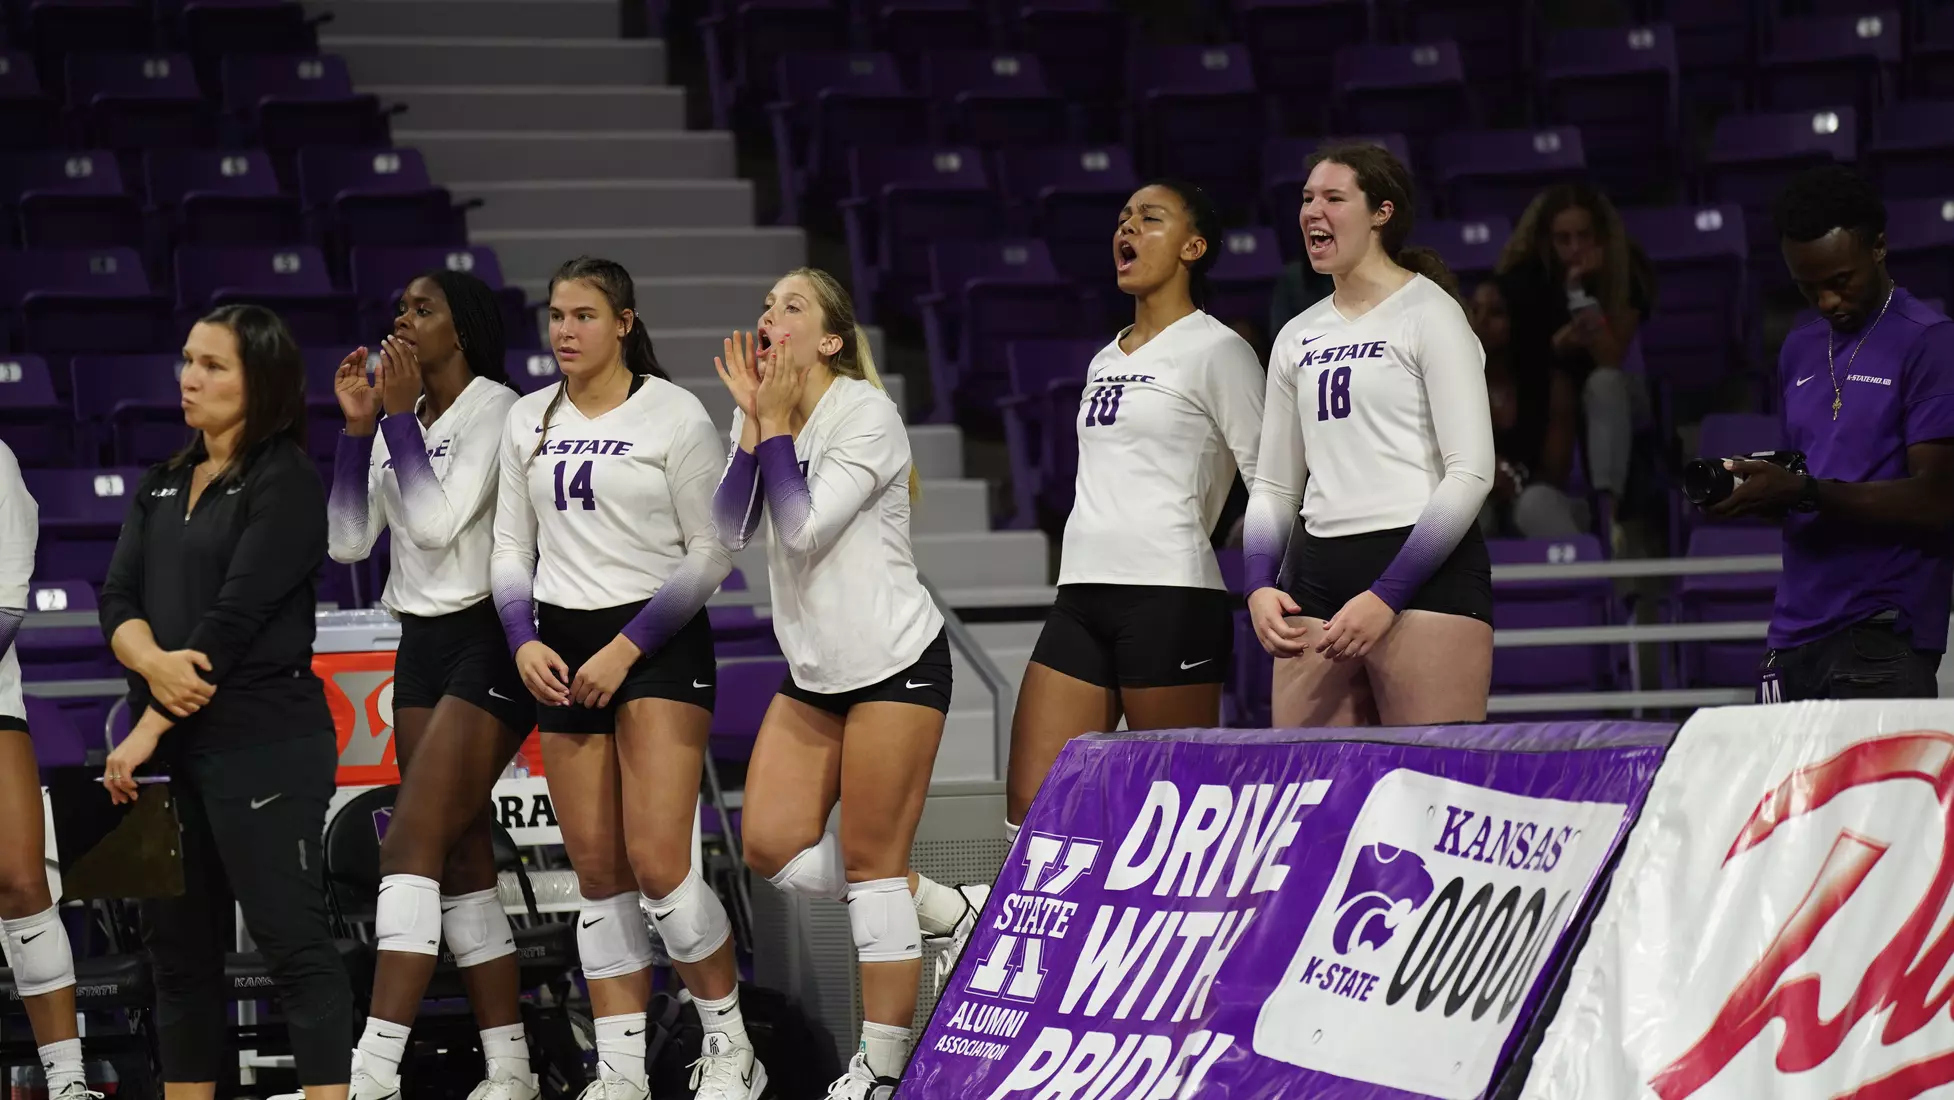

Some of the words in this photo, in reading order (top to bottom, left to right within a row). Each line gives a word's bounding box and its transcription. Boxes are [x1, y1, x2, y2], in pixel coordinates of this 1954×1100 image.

[1299, 341, 1387, 367] K-STATE
[1085, 384, 1126, 427] 10
[1317, 366, 1352, 422] 18
[536, 440, 634, 456] K-STATE
[553, 460, 596, 511] 14
[498, 794, 558, 828] RA
[1104, 780, 1333, 898] DRIVE
[1433, 805, 1572, 873] KANSAS
[993, 893, 1079, 939] STATE
[234, 976, 275, 988] KANS
[1058, 905, 1257, 1022] WITH
[1299, 956, 1380, 1002] K-STATE
[76, 984, 118, 998] STATE
[946, 1001, 1029, 1038] ALUMNI
[934, 1035, 1009, 1061] ASSOCIATION
